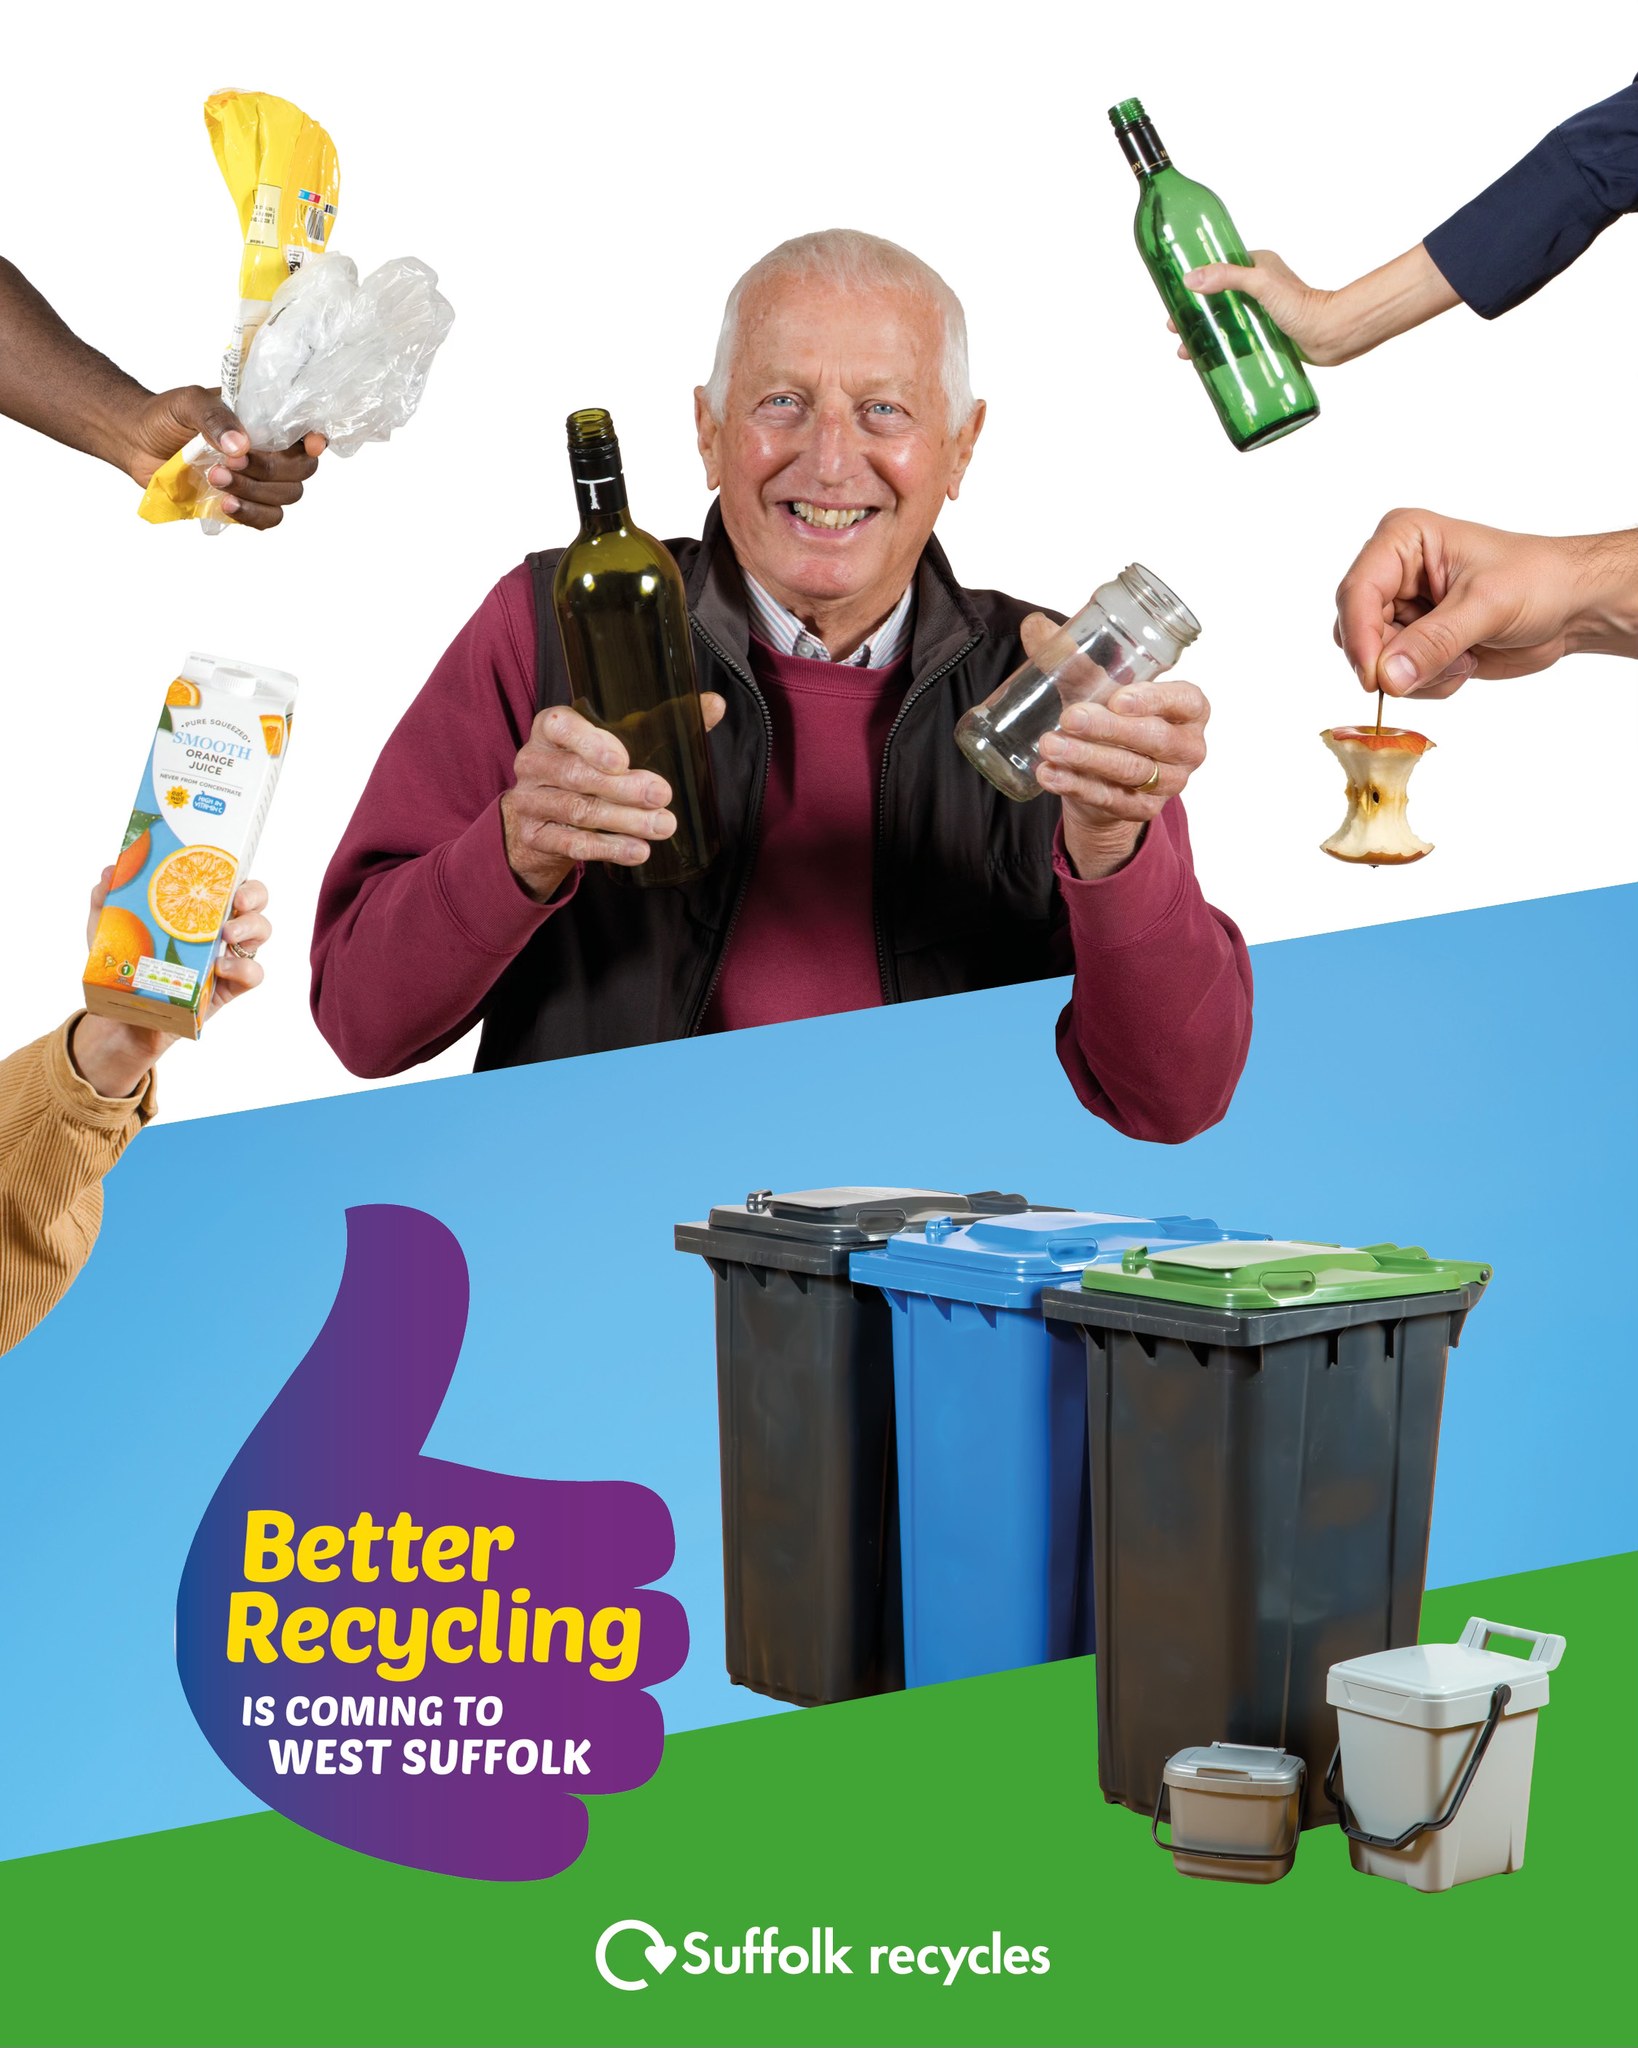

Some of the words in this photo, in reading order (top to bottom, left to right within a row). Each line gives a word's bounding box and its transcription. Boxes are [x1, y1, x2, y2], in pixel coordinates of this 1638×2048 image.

[185, 718, 207, 728] PURE
[210, 718, 249, 741] SQUEEZED
[172, 731, 253, 761] SMOOTH
[186, 749, 235, 768] ORANGE
[188, 761, 223, 776] JUICE
[160, 773, 179, 781] NEVER
[181, 776, 198, 785] FROM
[199, 781, 243, 797] CONCENTRATE
[197, 795, 214, 806] HIGH
[214, 799, 223, 807] IN
[244, 1510, 514, 1582] Better
[227, 1588, 641, 1681] Recycling
[242, 1696, 275, 1726] IS
[285, 1696, 443, 1726] COMING
[454, 1696, 504, 1726] TO
[268, 1739, 392, 1775] WEST
[402, 1739, 592, 1775] SUFFOLK
[682, 1926, 854, 1975] Suffolk
[870, 1931, 1051, 1986] recycles
